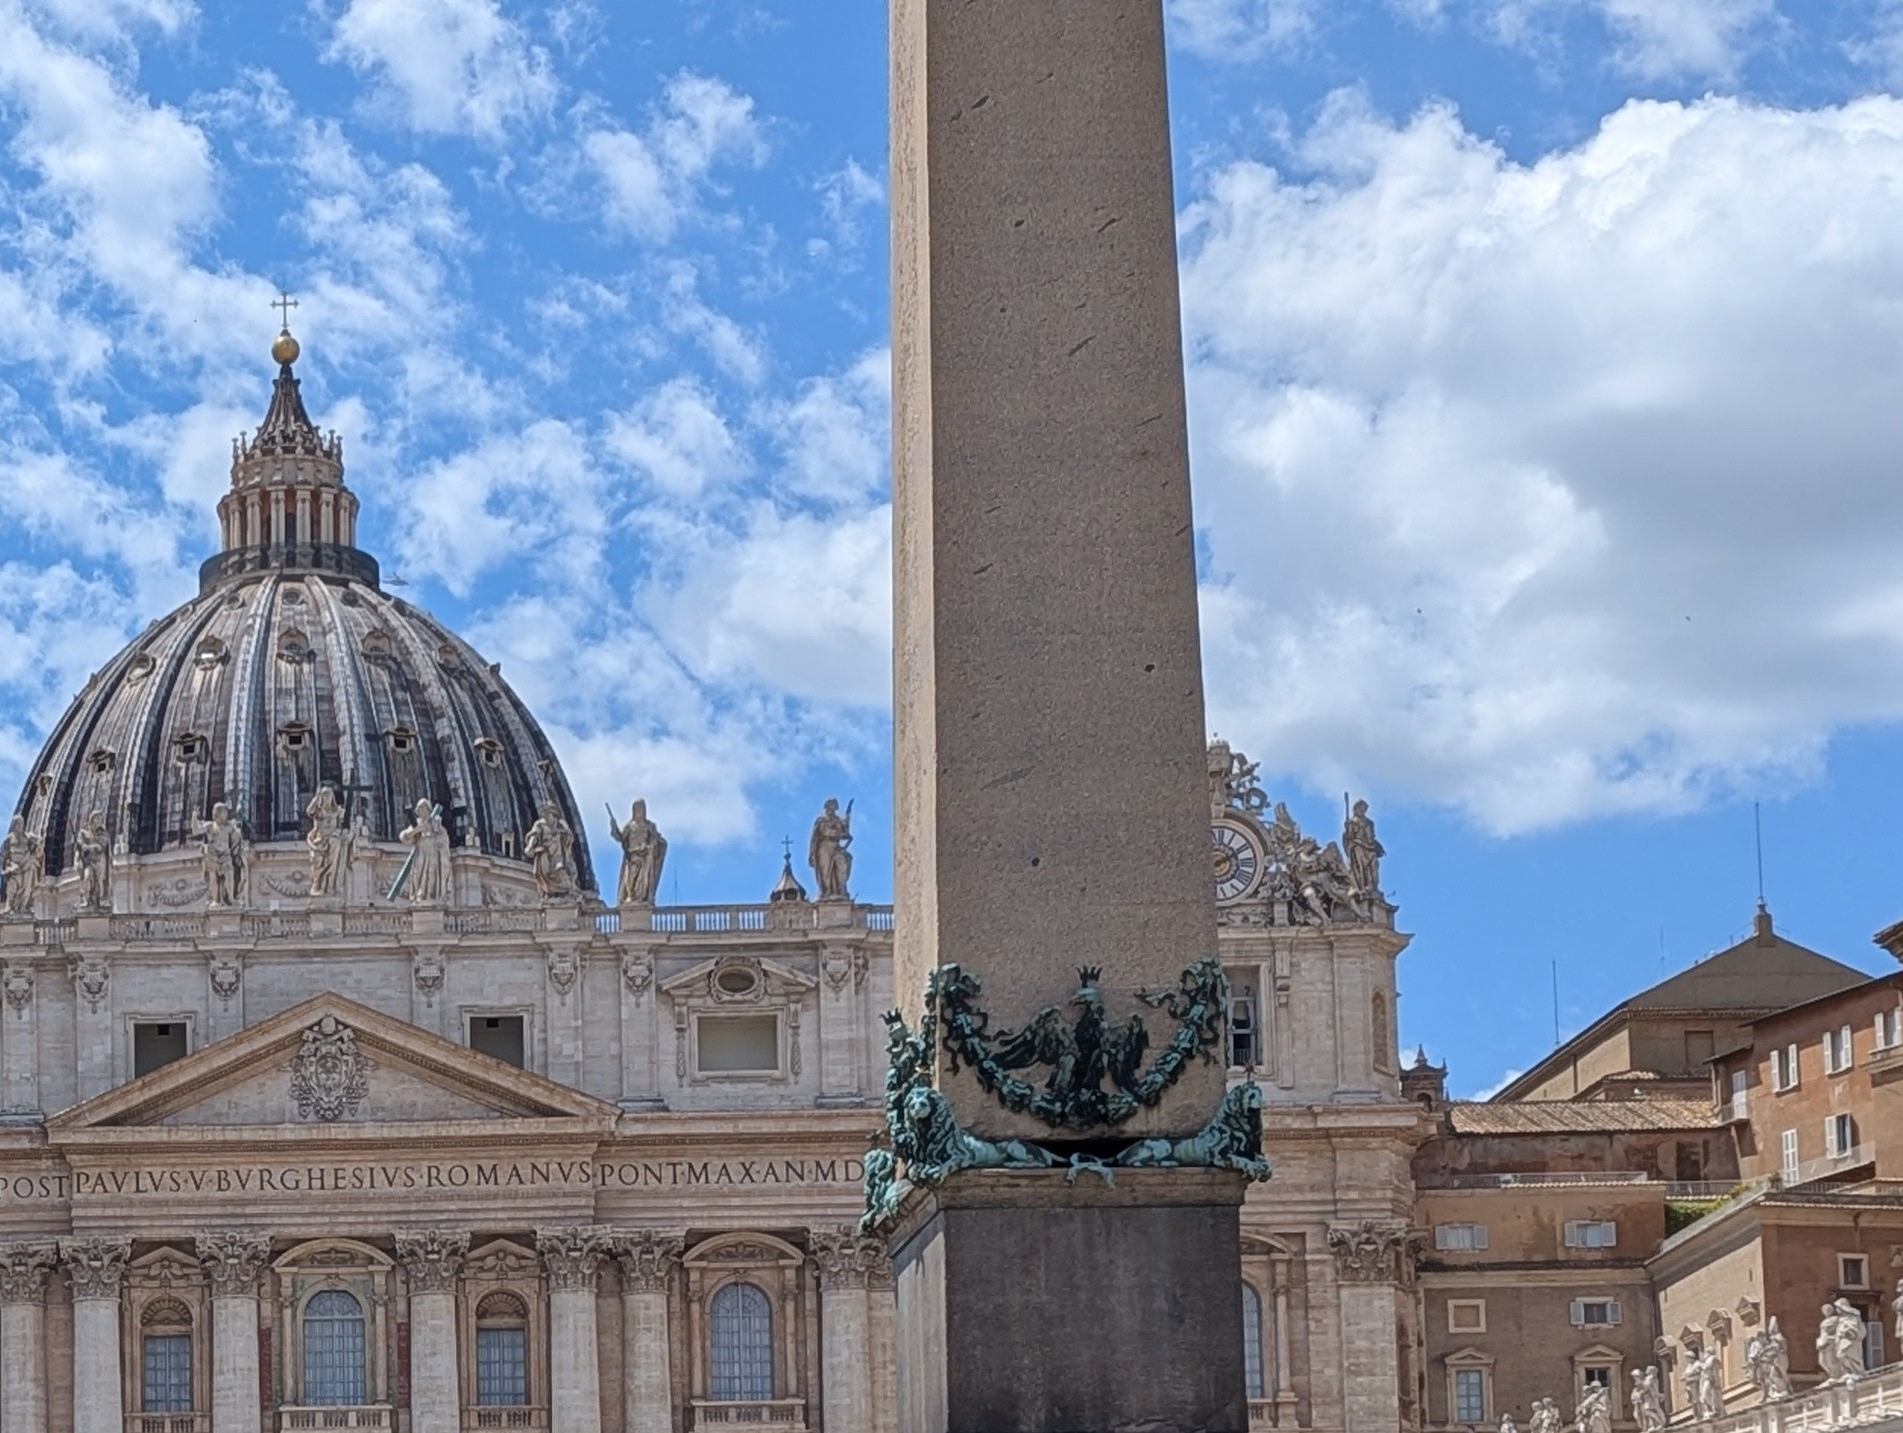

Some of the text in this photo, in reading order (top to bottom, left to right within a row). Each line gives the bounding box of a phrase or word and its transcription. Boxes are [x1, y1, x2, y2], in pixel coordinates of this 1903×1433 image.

[75, 1170, 182, 1194] PAVLVS
[188, 1169, 208, 1192] V
[216, 1166, 415, 1191] BVRGHESIVS
[426, 1161, 591, 1188] ROMANVS
[599, 1161, 684, 1186] PONT
[687, 1161, 759, 1185] MAX
[766, 1160, 807, 1184] AN
